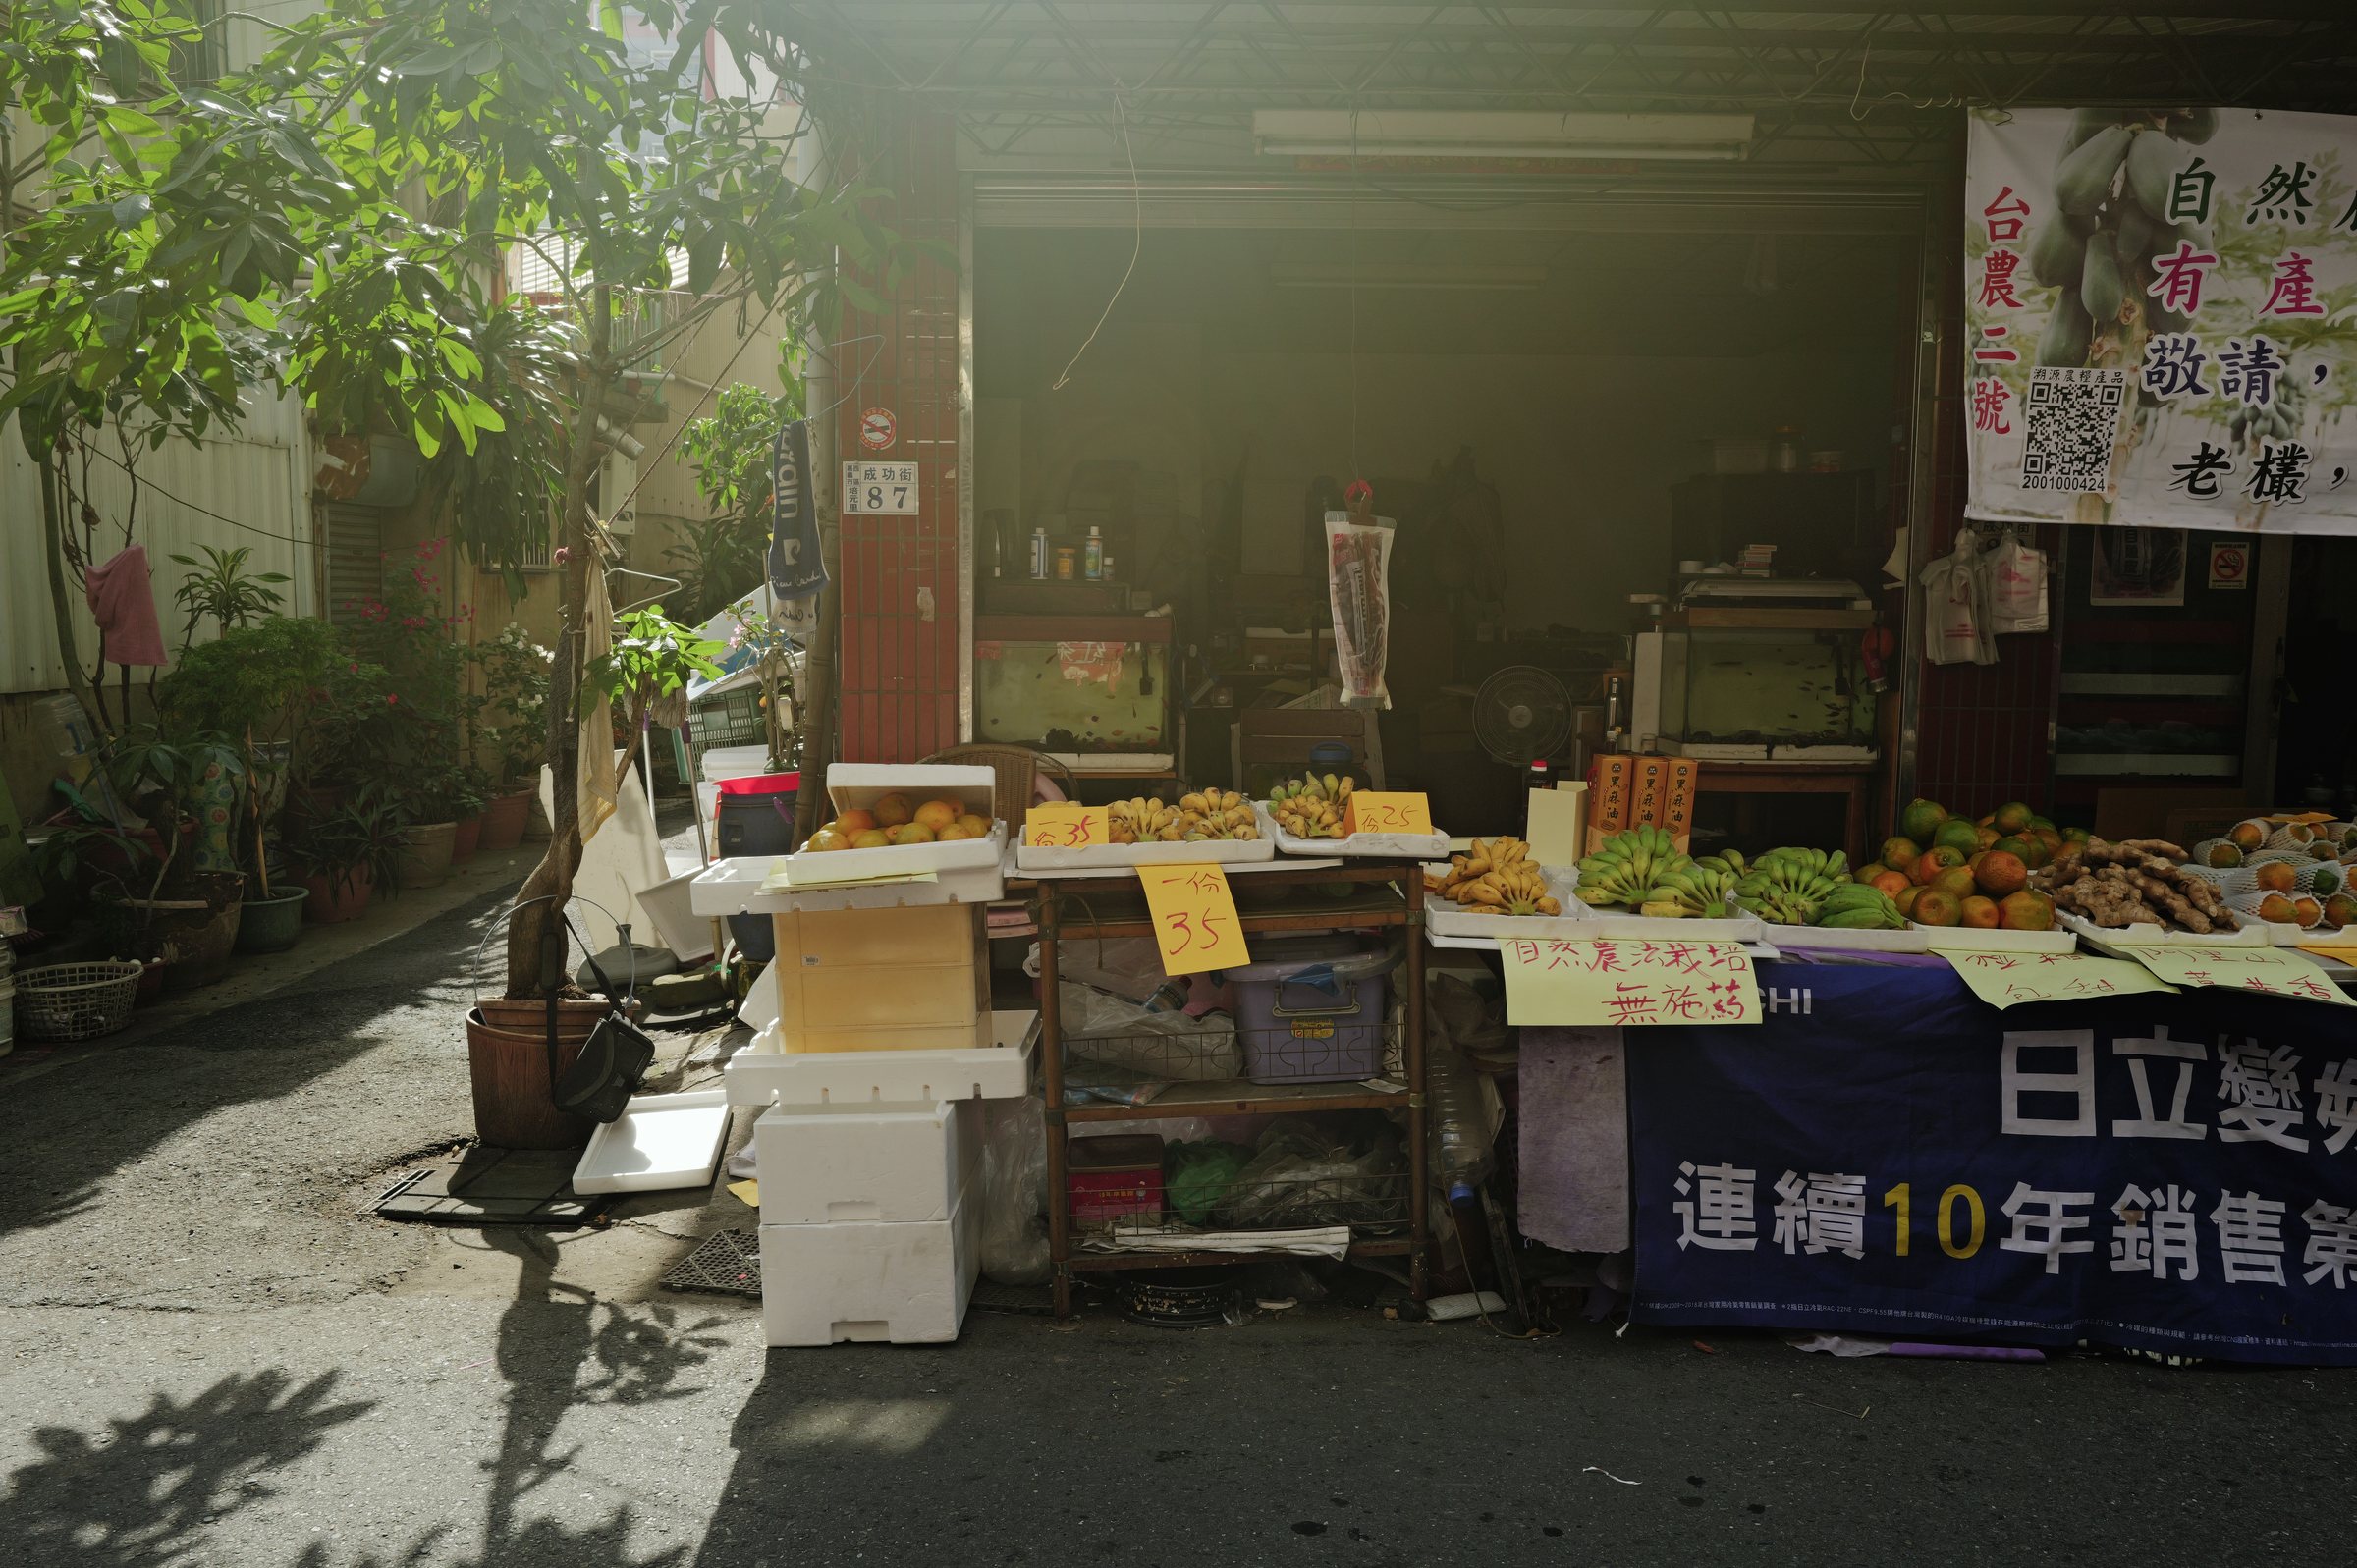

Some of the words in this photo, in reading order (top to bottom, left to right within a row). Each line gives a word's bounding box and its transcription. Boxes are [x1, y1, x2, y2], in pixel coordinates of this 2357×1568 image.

[1973, 186, 2031, 436] 台農二號
[2033, 368, 2124, 384] 溯源農糧產品
[863, 467, 912, 482] 成功街
[2021, 475, 2106, 492] 2001000424
[867, 486, 908, 509] 87
[1606, 776, 1621, 820] 黑麻油
[1640, 778, 1656, 822] 黑麻油
[1671, 779, 1686, 823] 黑麻油
[1063, 814, 1099, 846] 35
[1382, 805, 1418, 827] 25
[1162, 871, 1222, 895] 一份
[1166, 907, 1227, 955] 35
[1758, 986, 1812, 1015] HI
